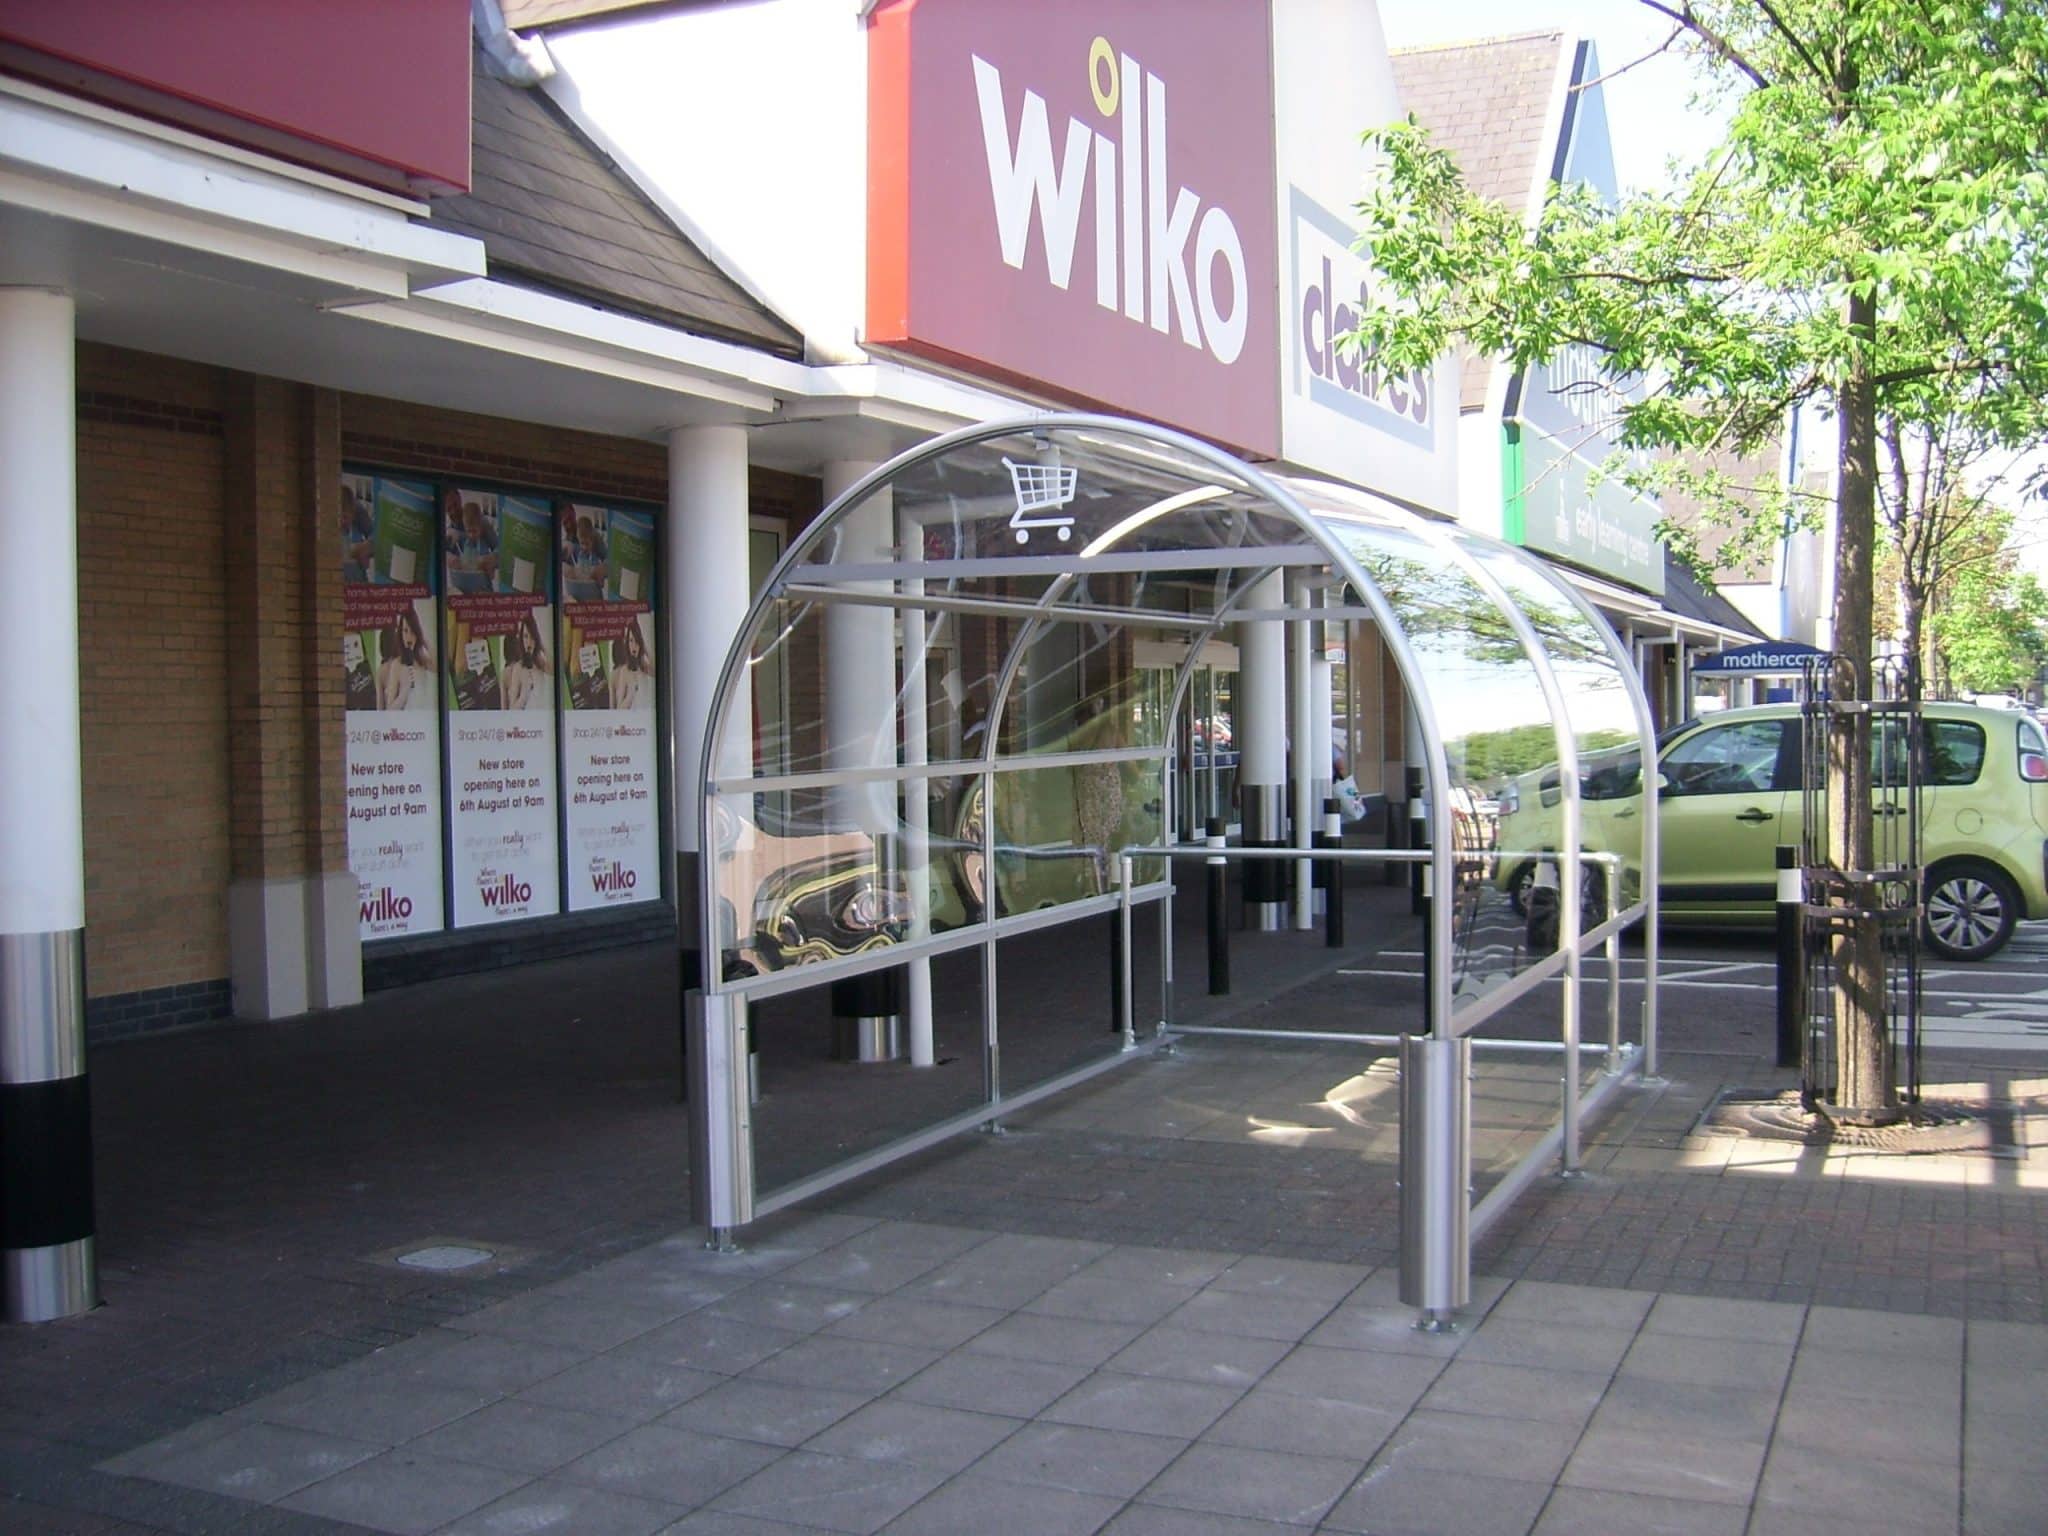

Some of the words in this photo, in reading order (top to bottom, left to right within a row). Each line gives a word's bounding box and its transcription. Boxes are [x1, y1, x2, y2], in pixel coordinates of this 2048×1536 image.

[971, 36, 1248, 364] wilko
[351, 763, 375, 776] New
[378, 762, 404, 775] store
[479, 758, 500, 770] New
[502, 758, 525, 770] store
[590, 755, 609, 766] New
[611, 754, 630, 765] store
[464, 778, 503, 793] opening
[505, 776, 526, 789] here
[528, 778, 541, 788] on
[577, 773, 612, 787] opening
[613, 772, 632, 782] here
[633, 772, 644, 782] on
[348, 784, 379, 800] ening
[382, 783, 405, 796] here
[408, 784, 422, 794] on
[574, 793, 588, 804] 6th
[589, 791, 618, 805] August
[619, 790, 629, 800] at
[629, 788, 648, 800] 9am
[349, 805, 387, 821] August
[390, 803, 402, 816] at
[403, 803, 427, 815] 9am
[460, 799, 475, 811] 6th
[477, 797, 510, 813] August
[512, 797, 522, 808] at
[524, 795, 545, 807] 9am
[503, 830, 524, 848] really
[379, 840, 404, 860] really
[592, 861, 636, 893] wilko
[481, 873, 532, 907] wilko
[359, 887, 412, 923] wilko
